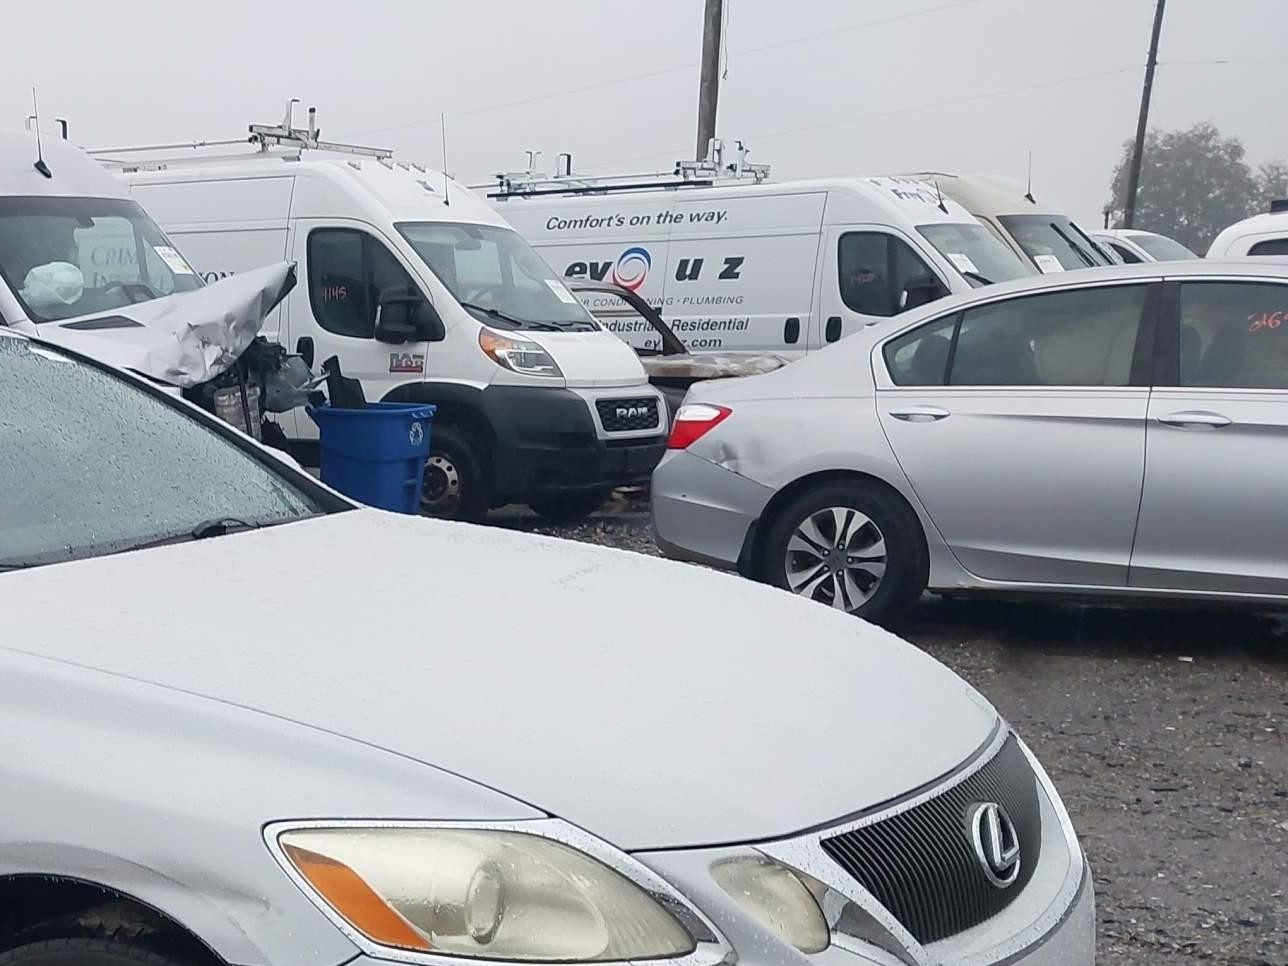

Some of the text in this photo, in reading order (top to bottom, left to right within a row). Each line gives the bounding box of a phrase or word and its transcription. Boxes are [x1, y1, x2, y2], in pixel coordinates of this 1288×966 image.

[546, 210, 728, 230] Comfort's on the way.
[682, 295, 745, 305] PLUMBING
[671, 317, 750, 331] Residential
[615, 406, 649, 419] RAM
